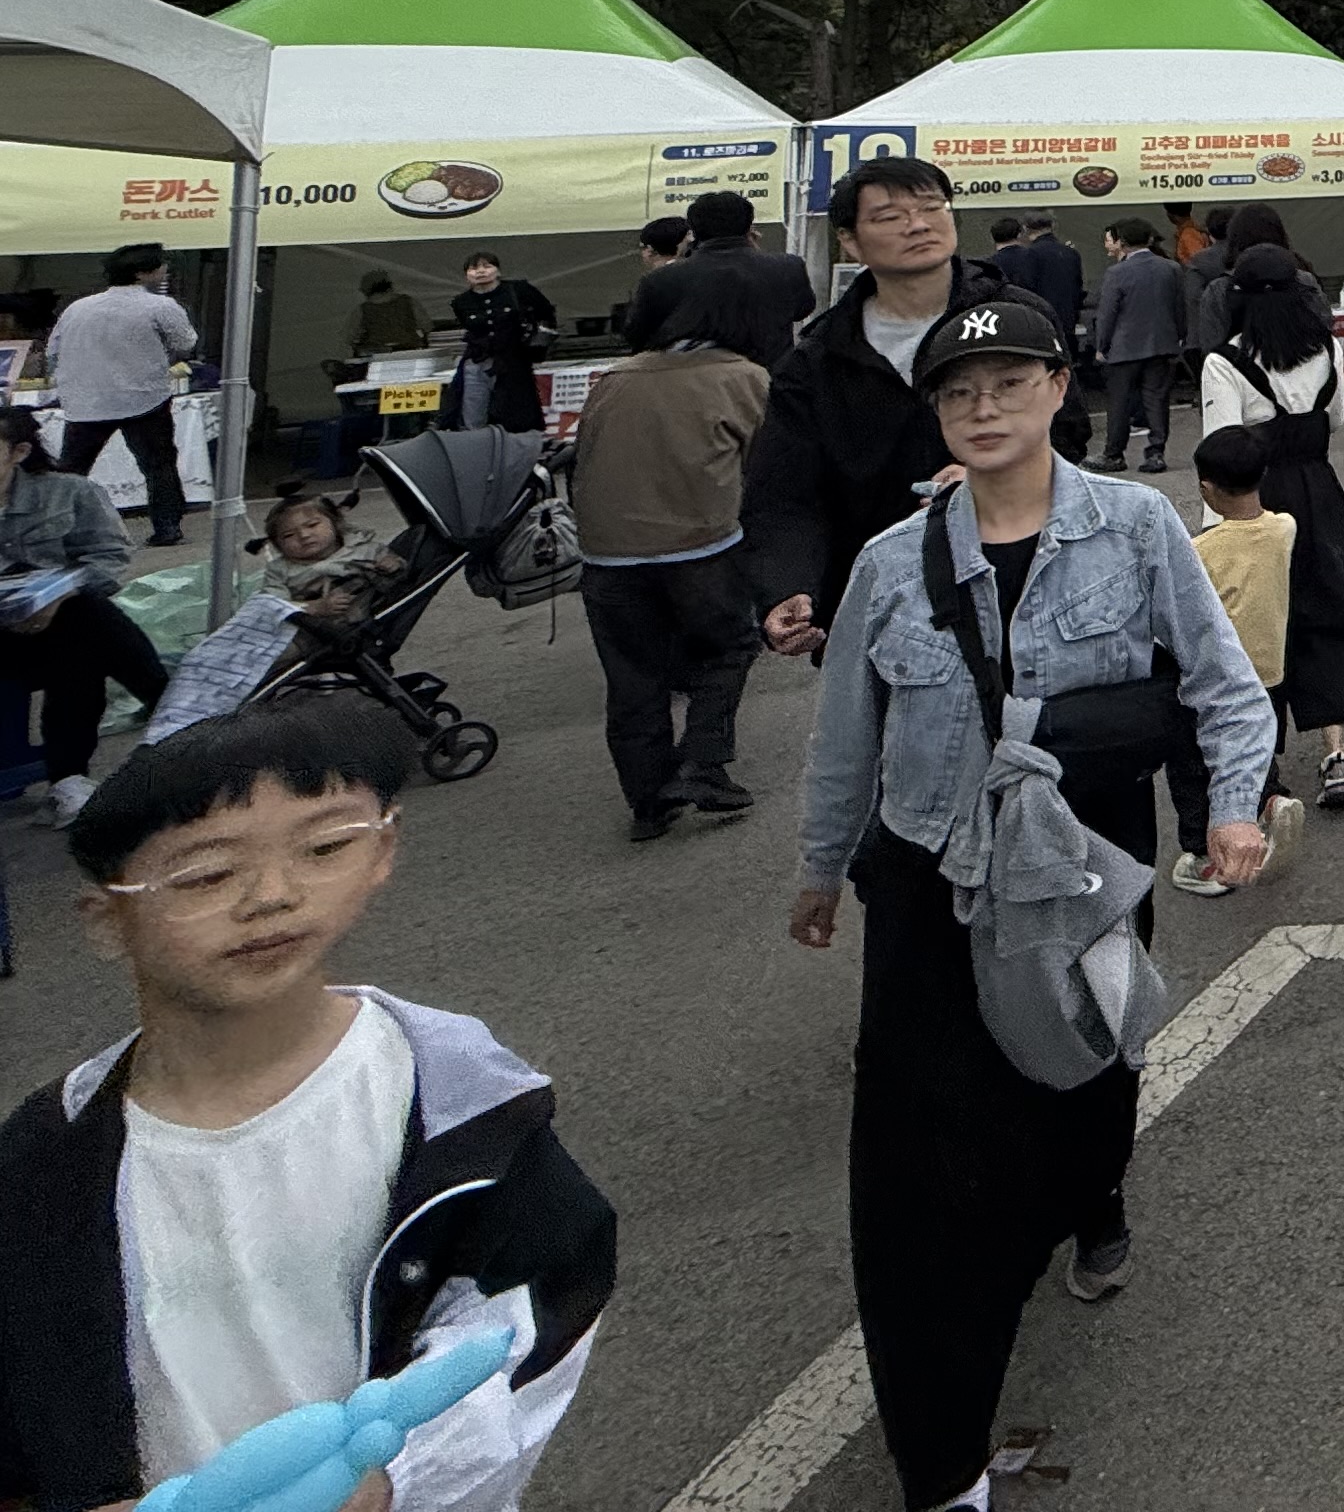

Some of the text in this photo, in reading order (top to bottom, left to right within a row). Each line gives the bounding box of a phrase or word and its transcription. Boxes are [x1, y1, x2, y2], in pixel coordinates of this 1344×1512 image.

[932, 137, 1117, 155] 유자품은 돼지양념갈비
[1141, 133, 1291, 151] 고추장 대패삼겹볶음
[996, 156, 1044, 166] Marinated
[1046, 155, 1067, 164] Pork
[1070, 155, 1090, 163] Ribs
[1168, 162, 1188, 170] Pork
[121, 177, 220, 205] 돈까스
[953, 180, 1002, 195] 5,000
[1138, 173, 1204, 191] ₩15,000
[120, 207, 216, 221] Pork Cutlet
[958, 309, 1000, 341] NY
